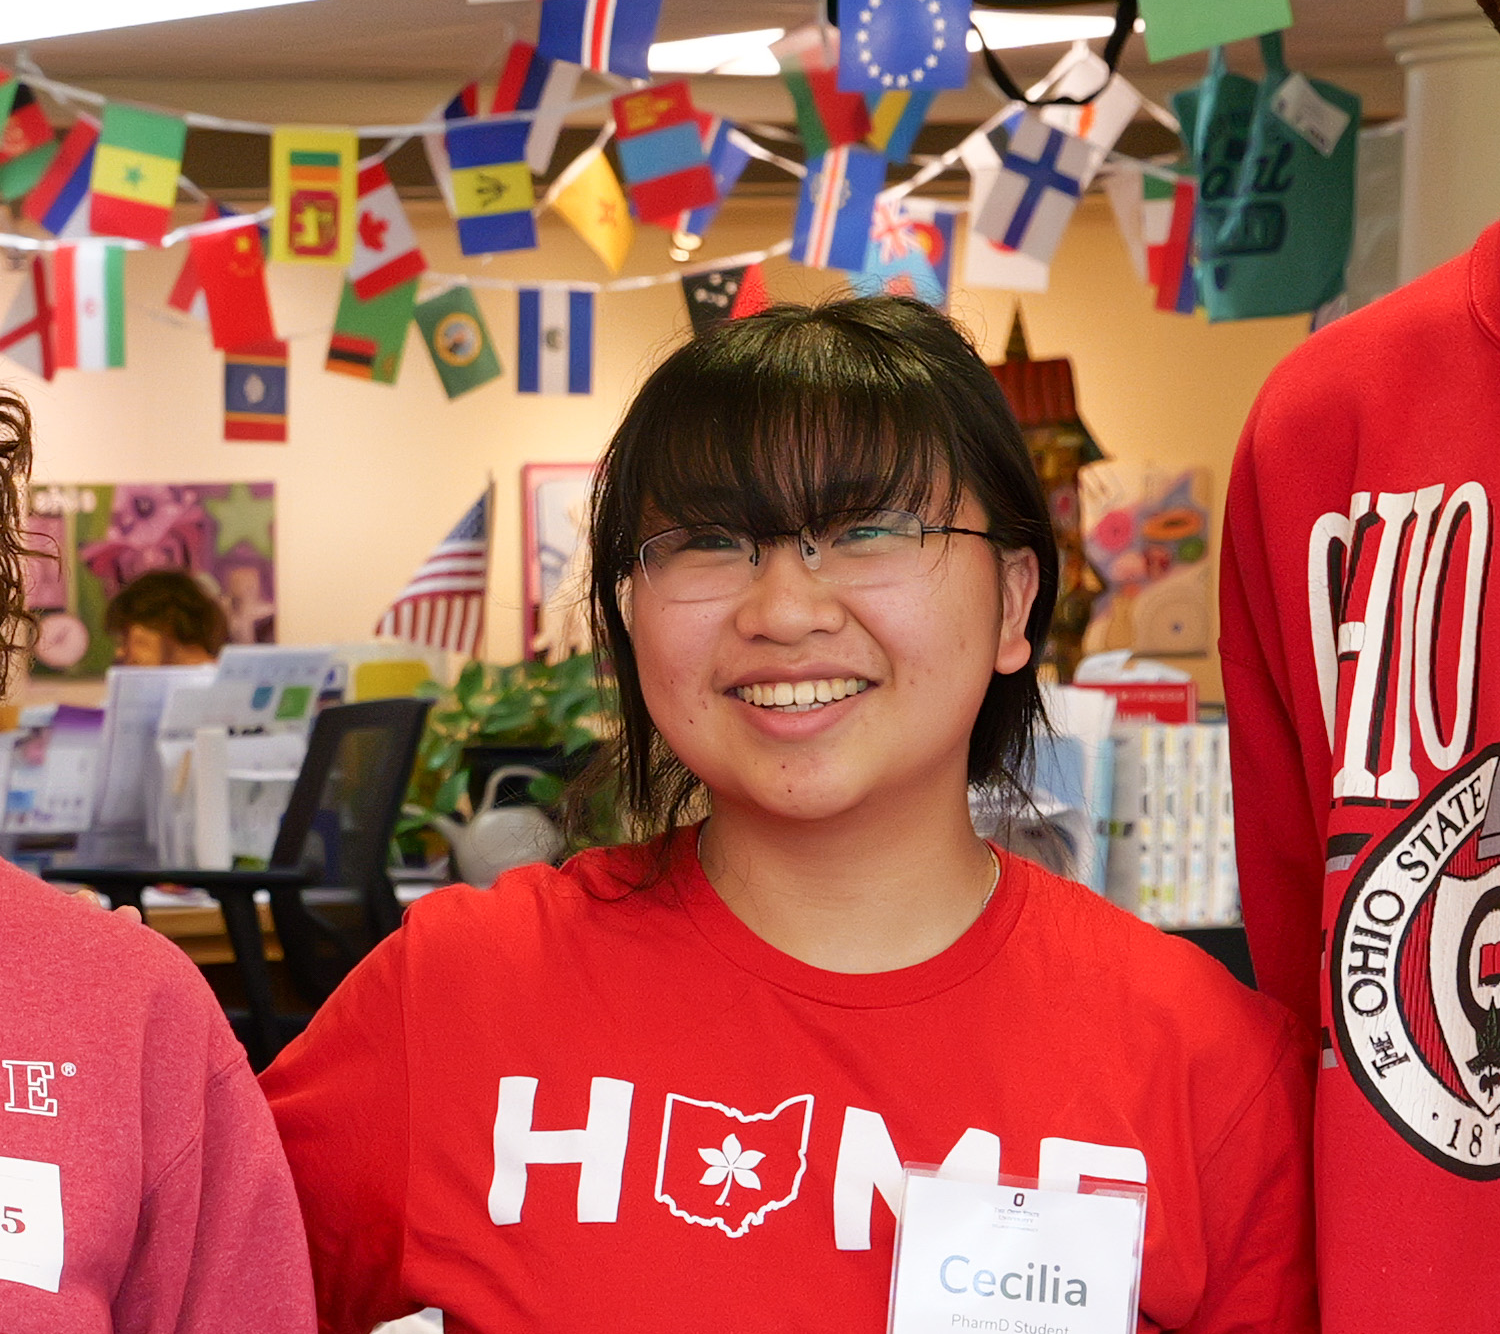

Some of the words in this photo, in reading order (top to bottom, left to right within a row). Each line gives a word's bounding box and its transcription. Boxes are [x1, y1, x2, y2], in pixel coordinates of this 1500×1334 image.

[1396, 779, 1485, 884] STATE
[1348, 887, 1408, 1017] OHIO
[1374, 1032, 1411, 1078] THE
[939, 1254, 1087, 1307] Cecilia
[951, 1314, 1010, 1332] PharmD
